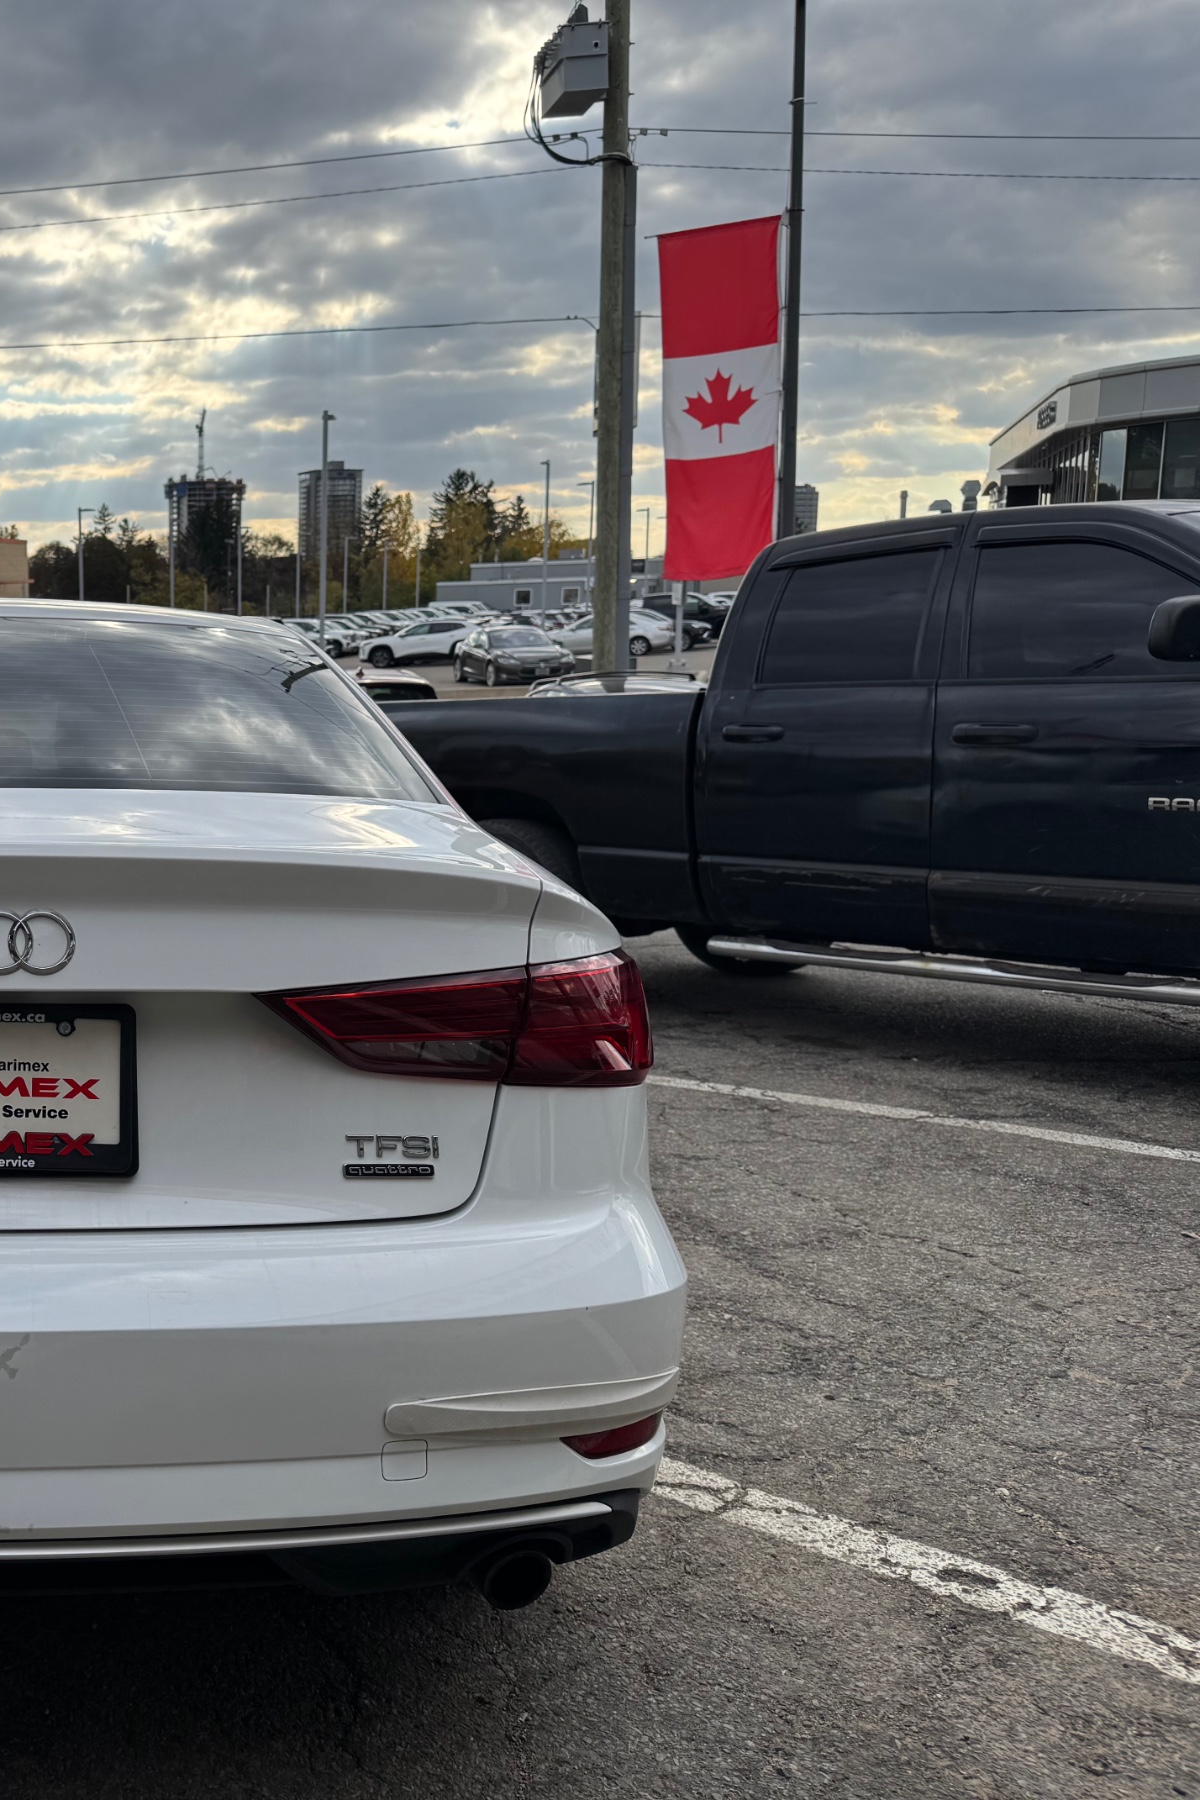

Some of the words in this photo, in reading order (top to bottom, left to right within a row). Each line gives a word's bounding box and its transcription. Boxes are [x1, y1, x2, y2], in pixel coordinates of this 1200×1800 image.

[1147, 796, 1200, 812] RA
[2, 1104, 69, 1120] Service
[344, 1134, 440, 1159] TFSI
[348, 1165, 431, 1176] quattro
